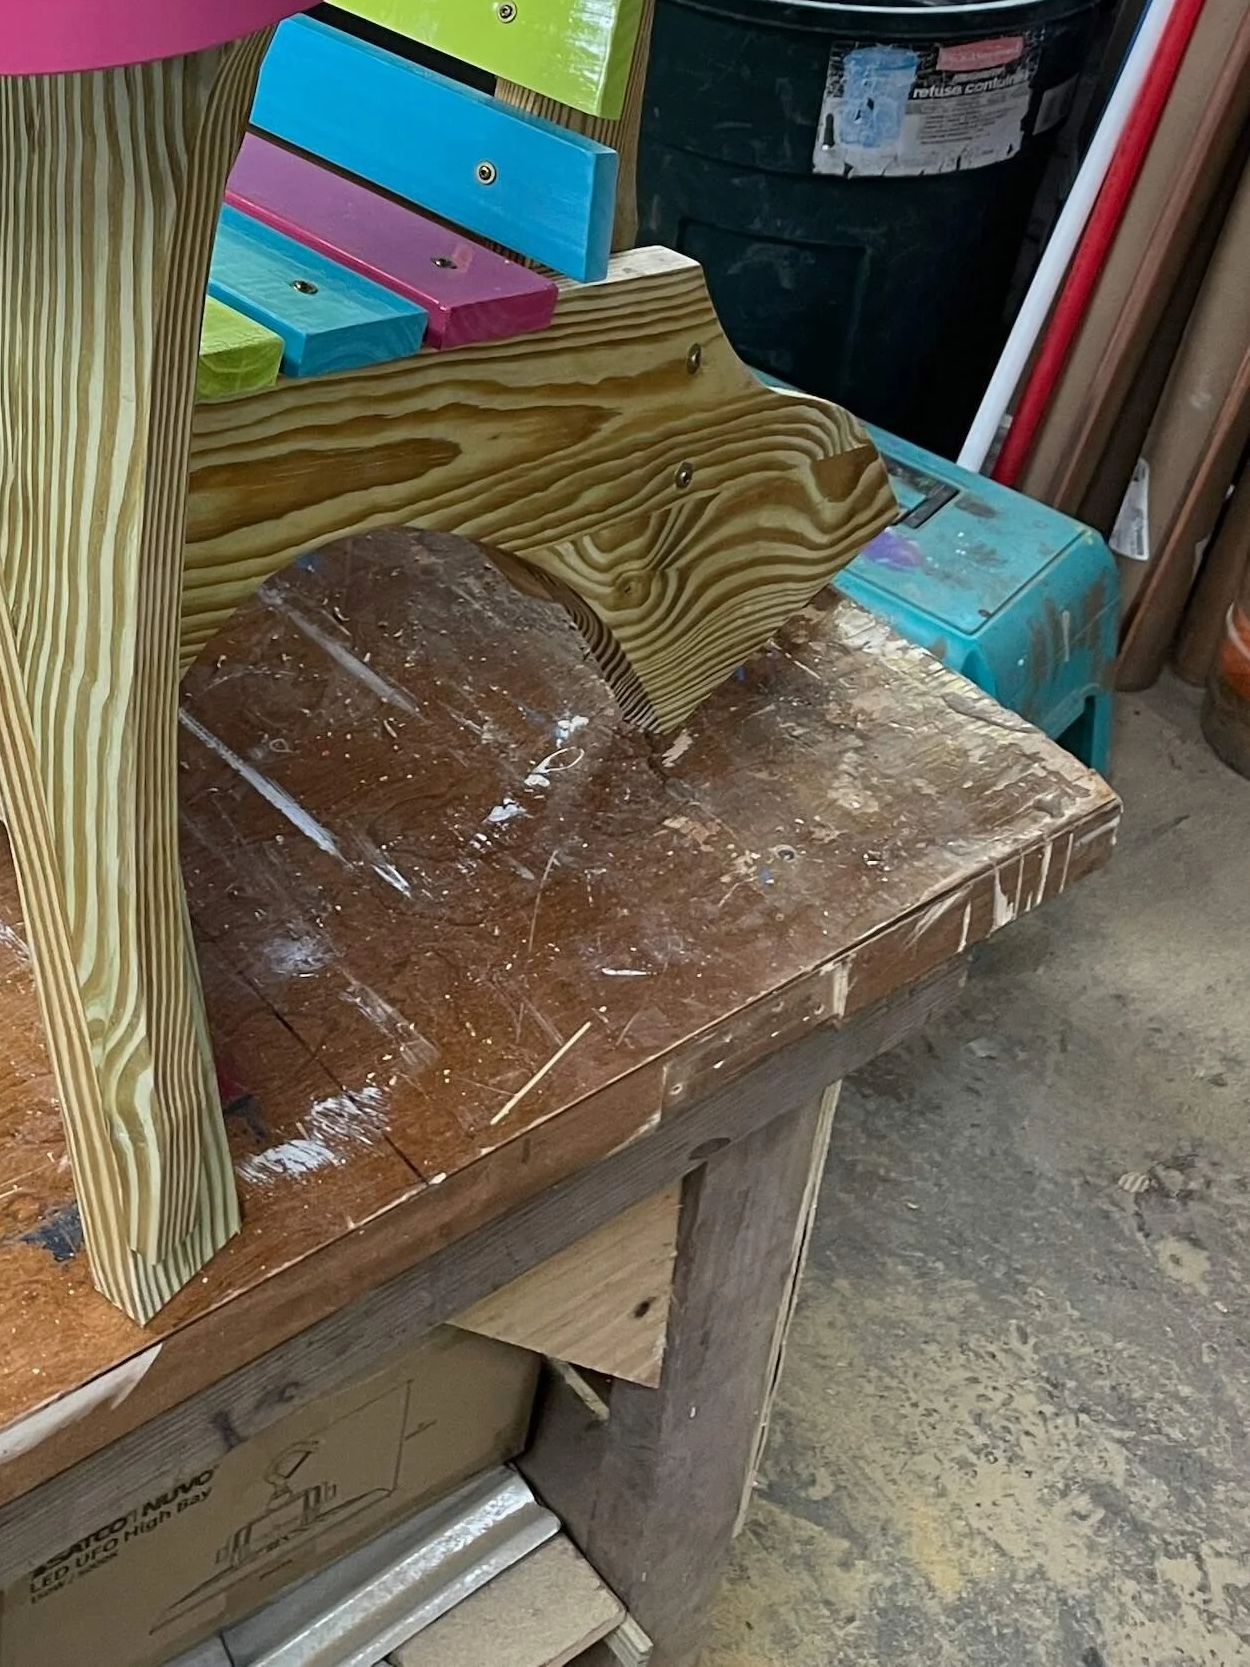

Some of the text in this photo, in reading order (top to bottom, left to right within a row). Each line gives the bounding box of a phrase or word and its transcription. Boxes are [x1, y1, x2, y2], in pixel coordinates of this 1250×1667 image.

[913, 83, 962, 98] refuse
[29, 1564, 70, 1594] LED
[75, 1537, 119, 1568] UFO
[123, 1511, 172, 1543] High
[176, 1487, 213, 1514] Bay
[46, 1517, 127, 1567] SATCO
[141, 1469, 214, 1517] NUVO
